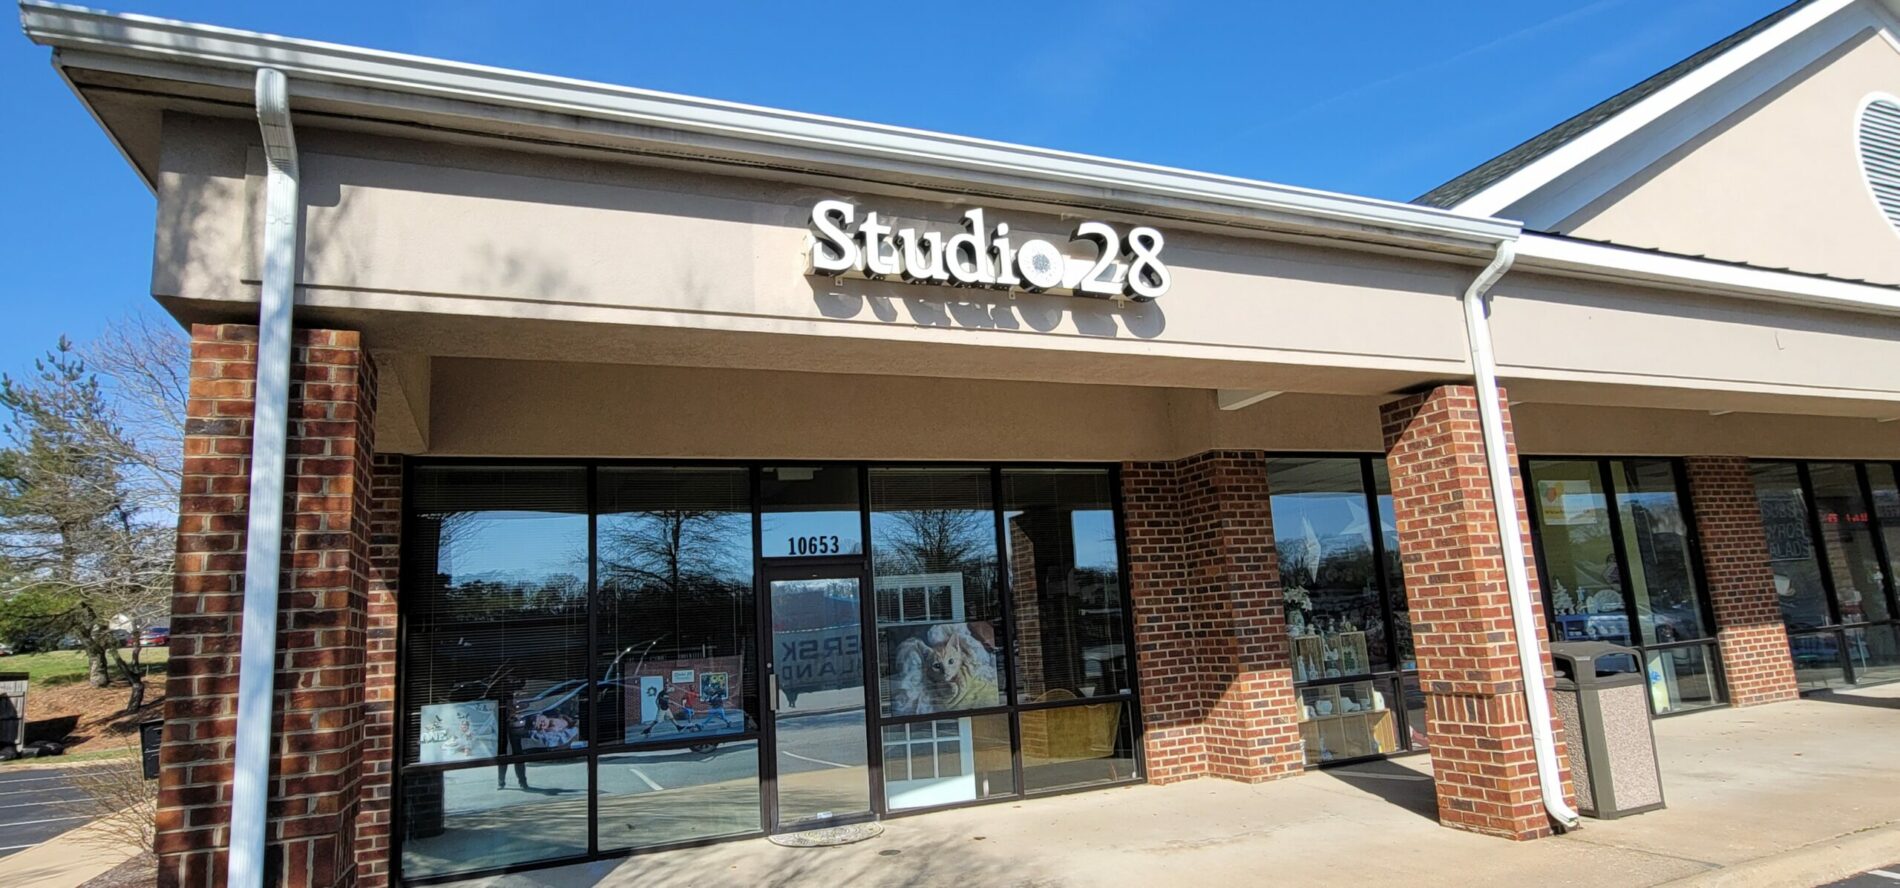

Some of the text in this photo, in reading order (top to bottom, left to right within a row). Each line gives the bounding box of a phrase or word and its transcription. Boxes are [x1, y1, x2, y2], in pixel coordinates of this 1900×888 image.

[811, 199, 1171, 299] Studio 28
[1766, 522, 1804, 540] YROS
[788, 535, 840, 556] 10653
